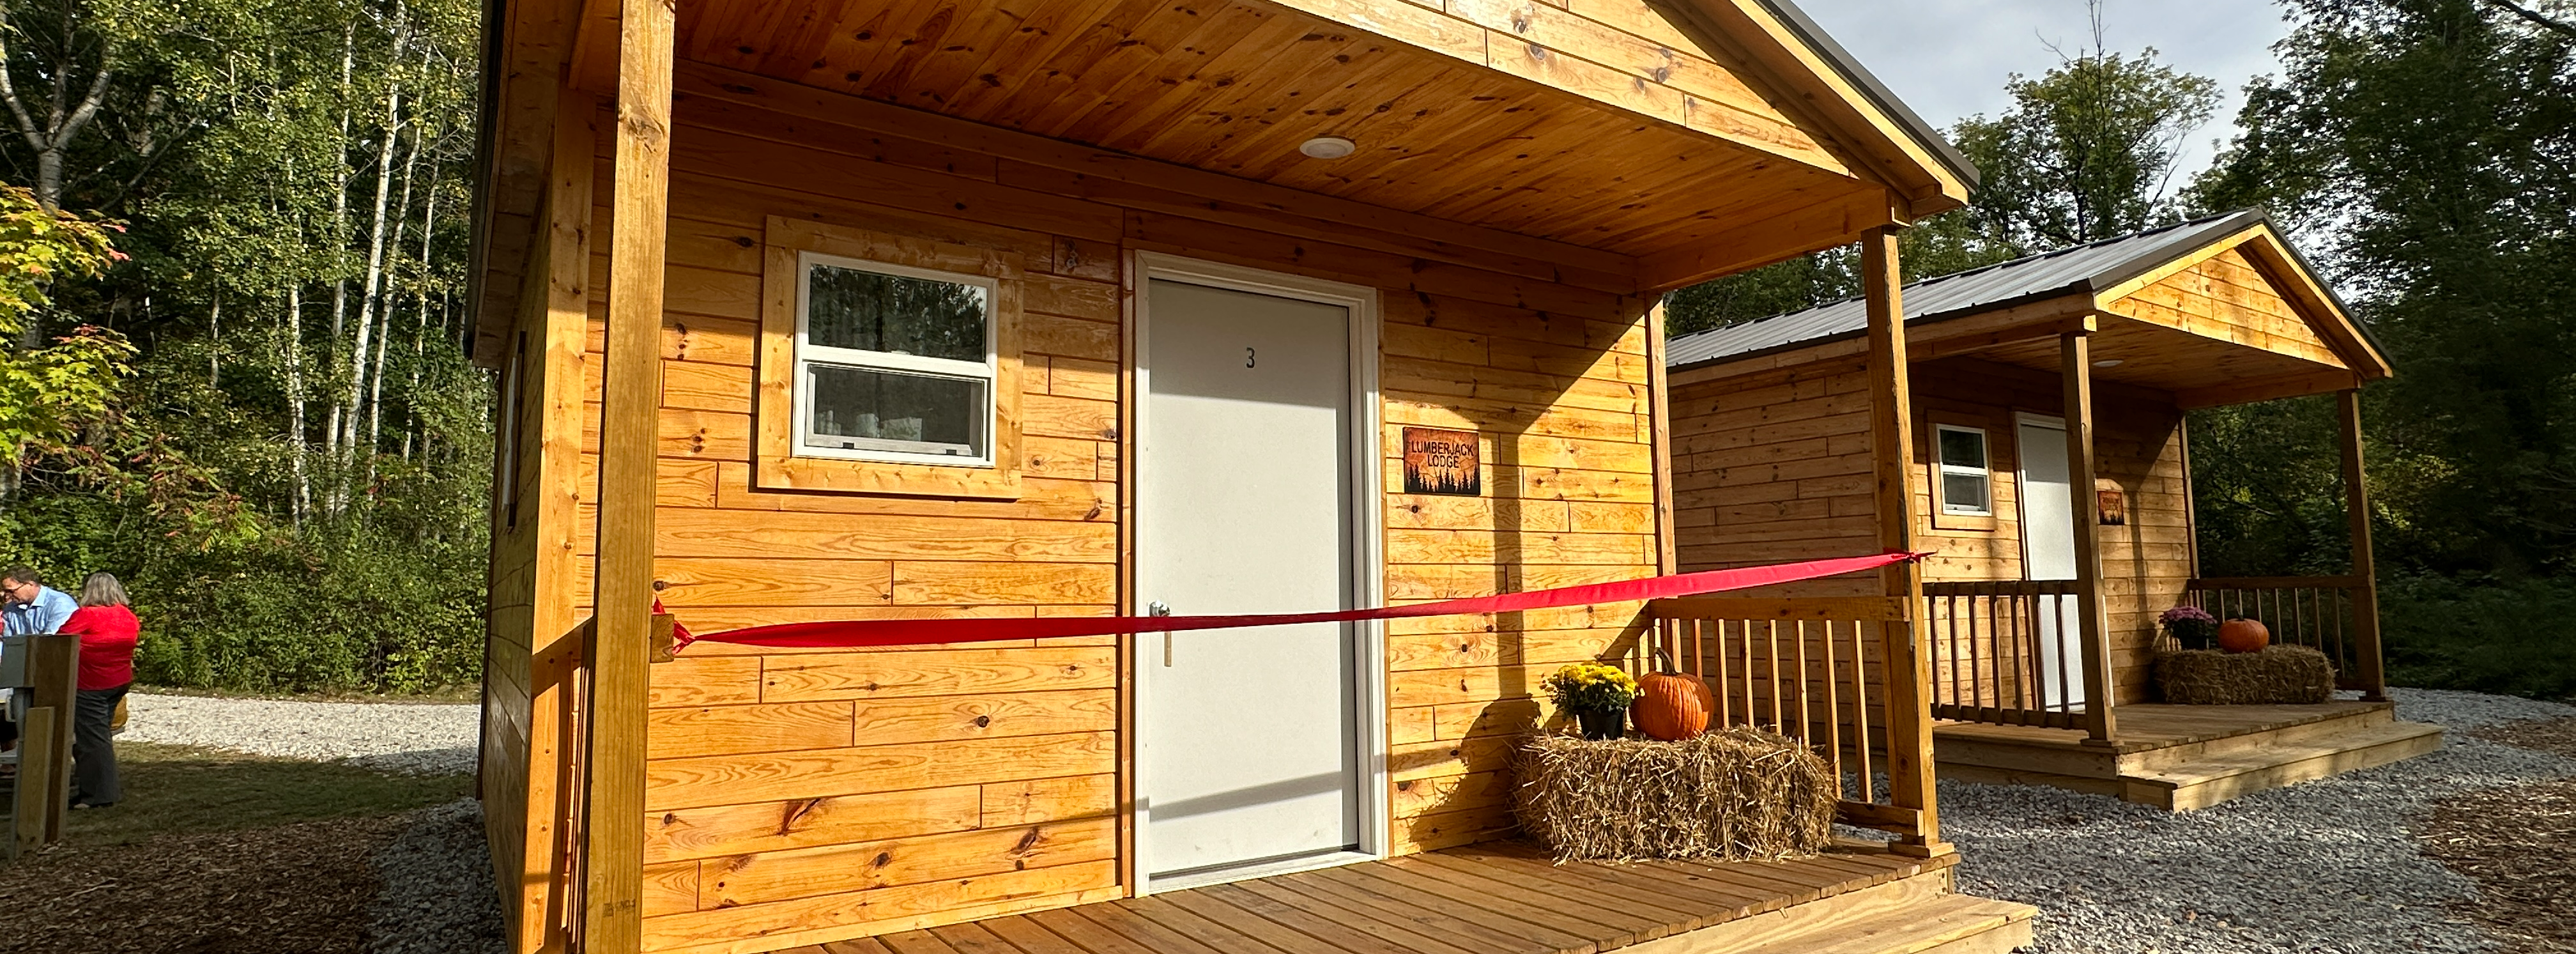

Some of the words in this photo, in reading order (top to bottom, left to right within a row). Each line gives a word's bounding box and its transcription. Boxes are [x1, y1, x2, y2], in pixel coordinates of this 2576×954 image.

[1246, 347, 1255, 368] 3
[1411, 441, 1474, 456] LUMBERJACK
[1427, 454, 1459, 468] LODGE
